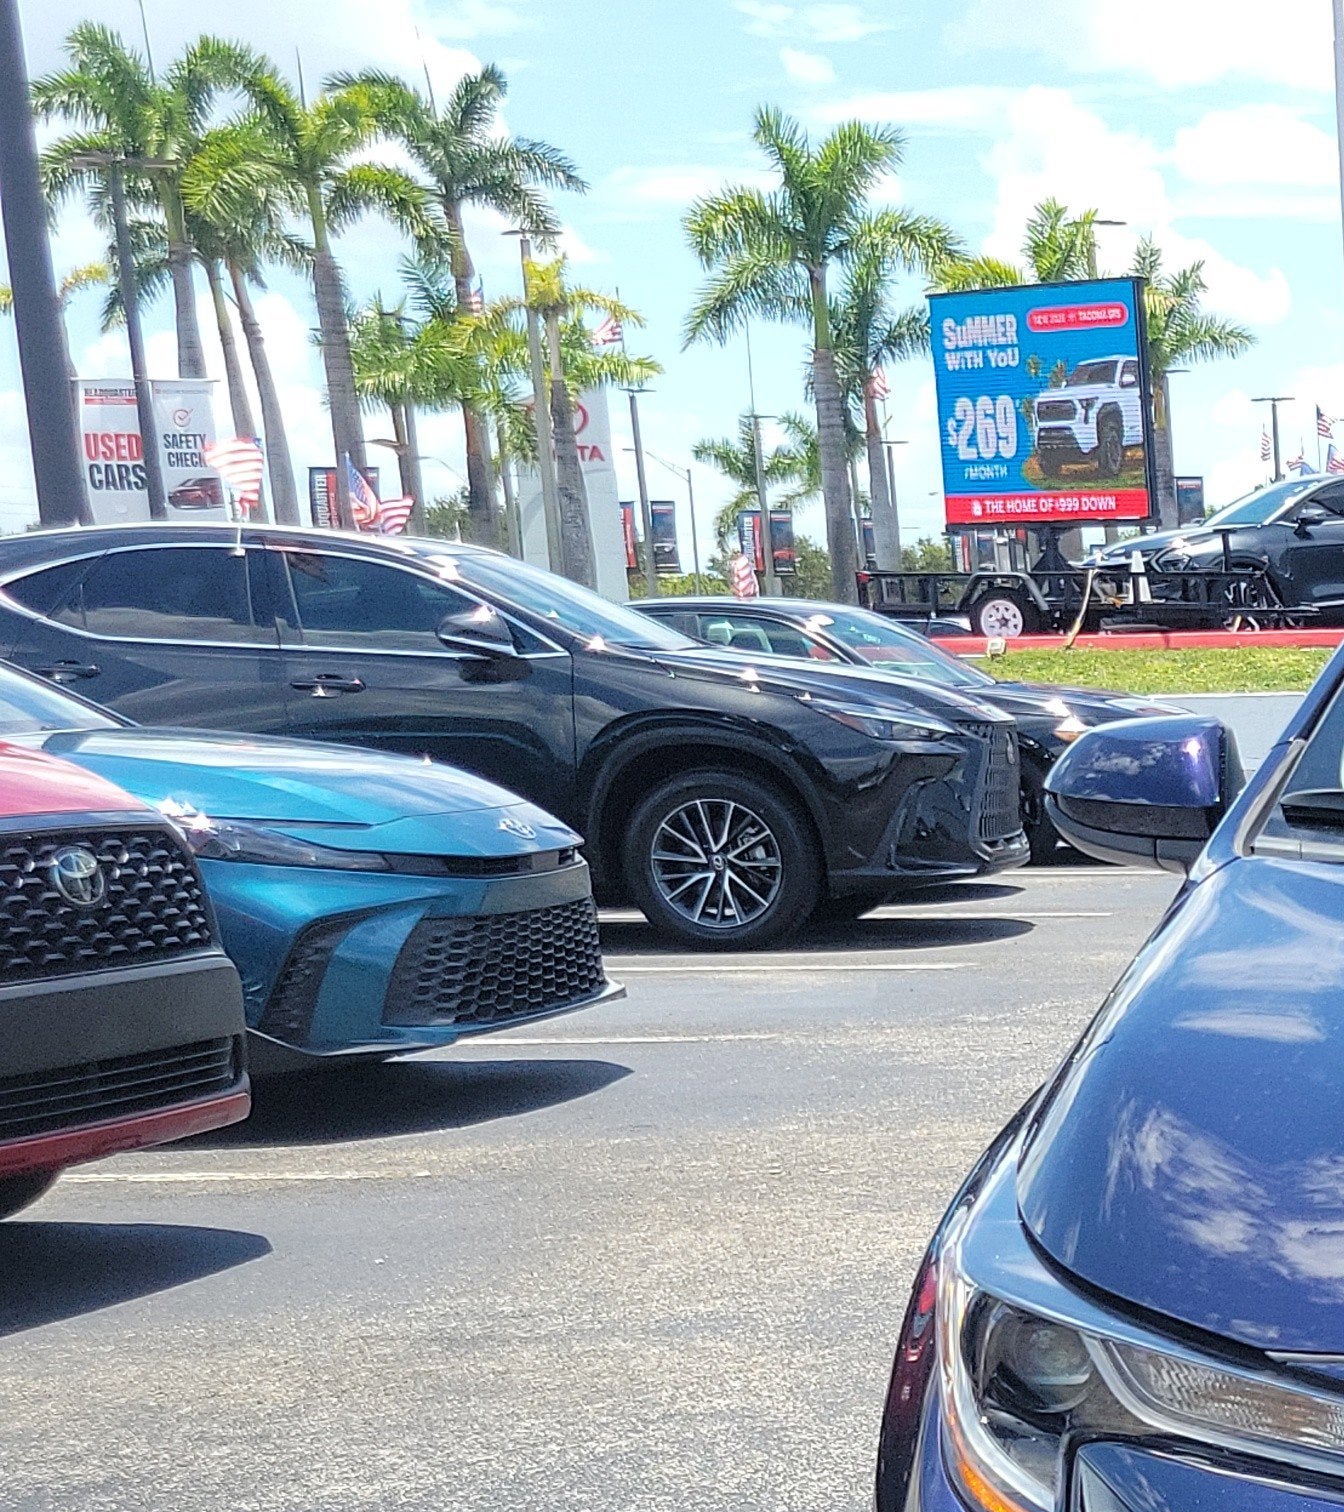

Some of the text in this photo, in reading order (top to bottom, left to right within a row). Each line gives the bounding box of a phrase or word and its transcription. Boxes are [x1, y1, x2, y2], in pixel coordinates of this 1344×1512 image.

[84, 433, 143, 462] USED
[163, 433, 207, 450] SAFETY
[89, 463, 148, 492] CARS
[984, 500, 1006, 514] THE
[1006, 499, 1038, 514] HOME
[1039, 498, 1055, 513] OF
[1081, 496, 1117, 511] DOWN
